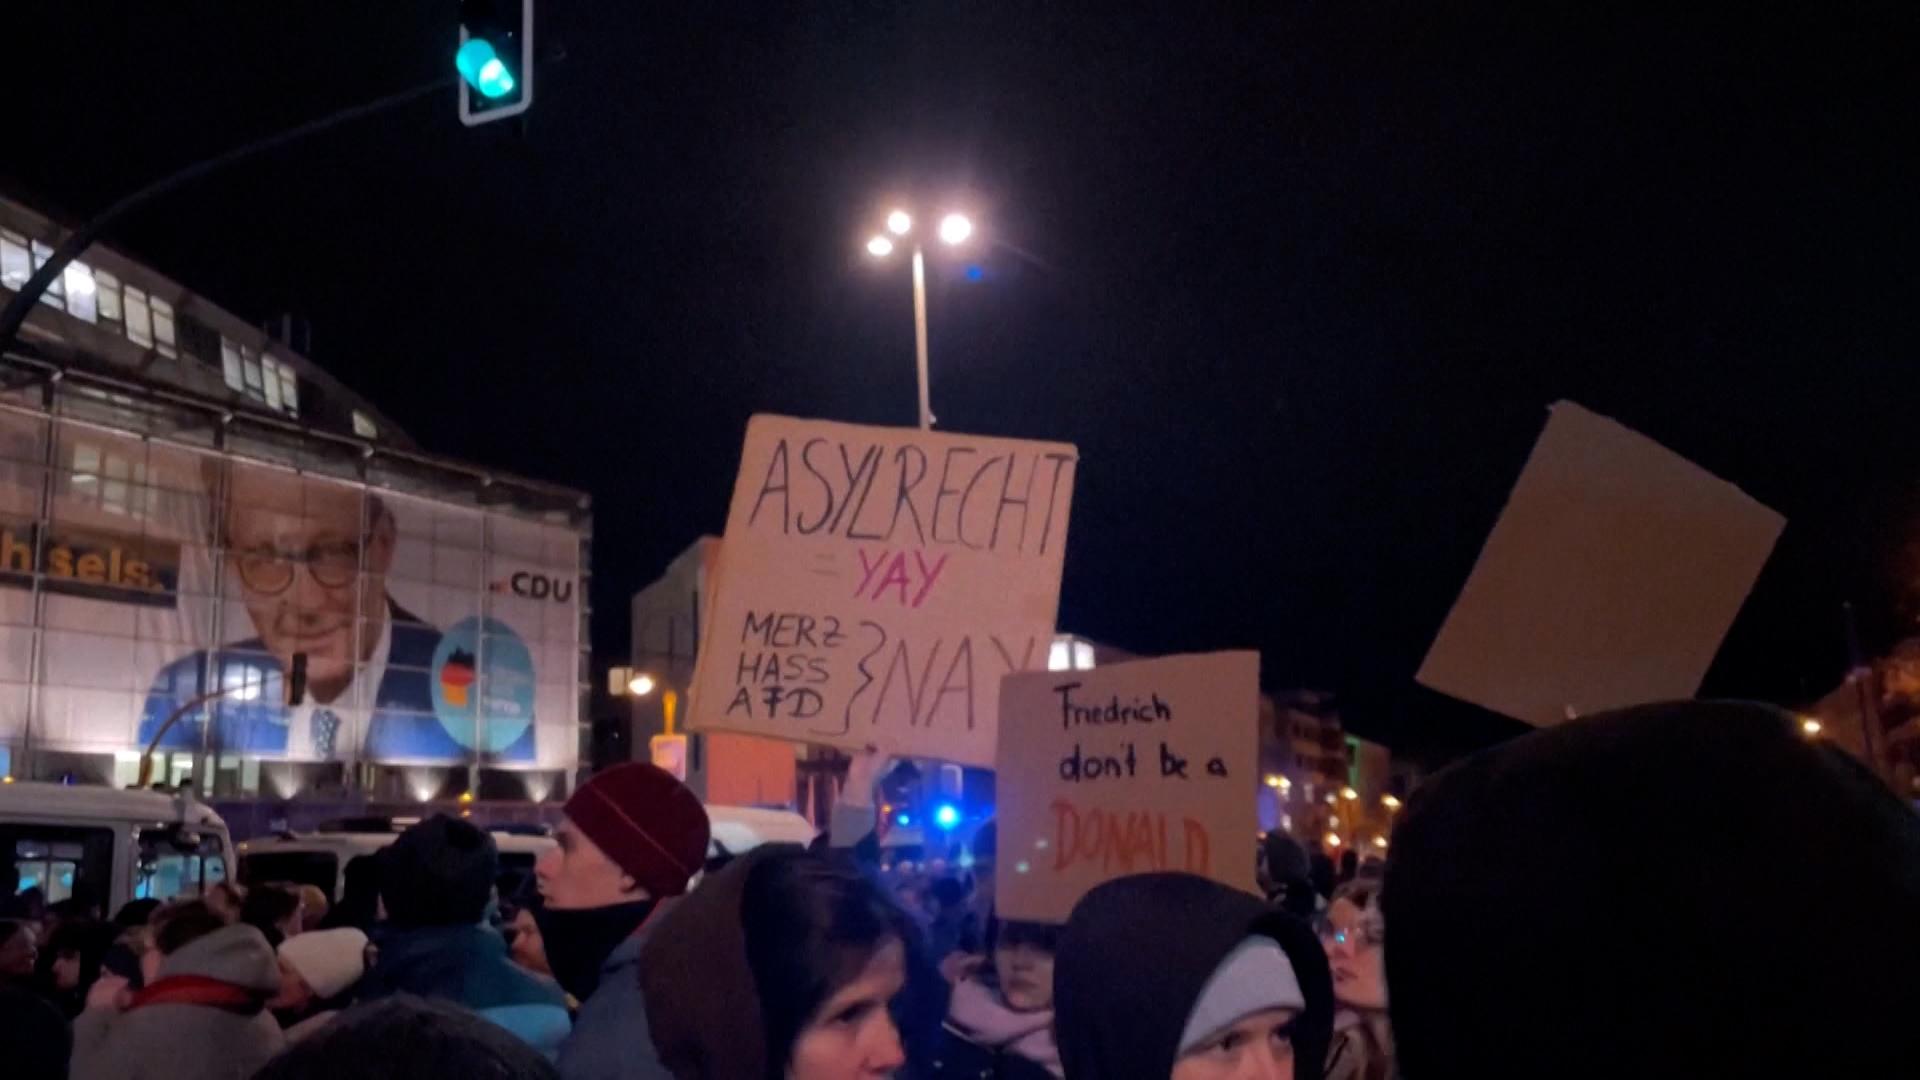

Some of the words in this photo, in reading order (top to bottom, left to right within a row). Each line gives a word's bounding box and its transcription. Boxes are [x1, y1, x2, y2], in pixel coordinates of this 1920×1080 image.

[748, 438, 1076, 555] ASYLRECHT
[510, 571, 572, 603] CDU
[854, 548, 948, 608] YAY
[741, 610, 848, 648] MERZ
[735, 652, 830, 686] HASS
[1053, 682, 1172, 730] Friedrich
[1159, 741, 1188, 779] be
[1206, 757, 1228, 777] a
